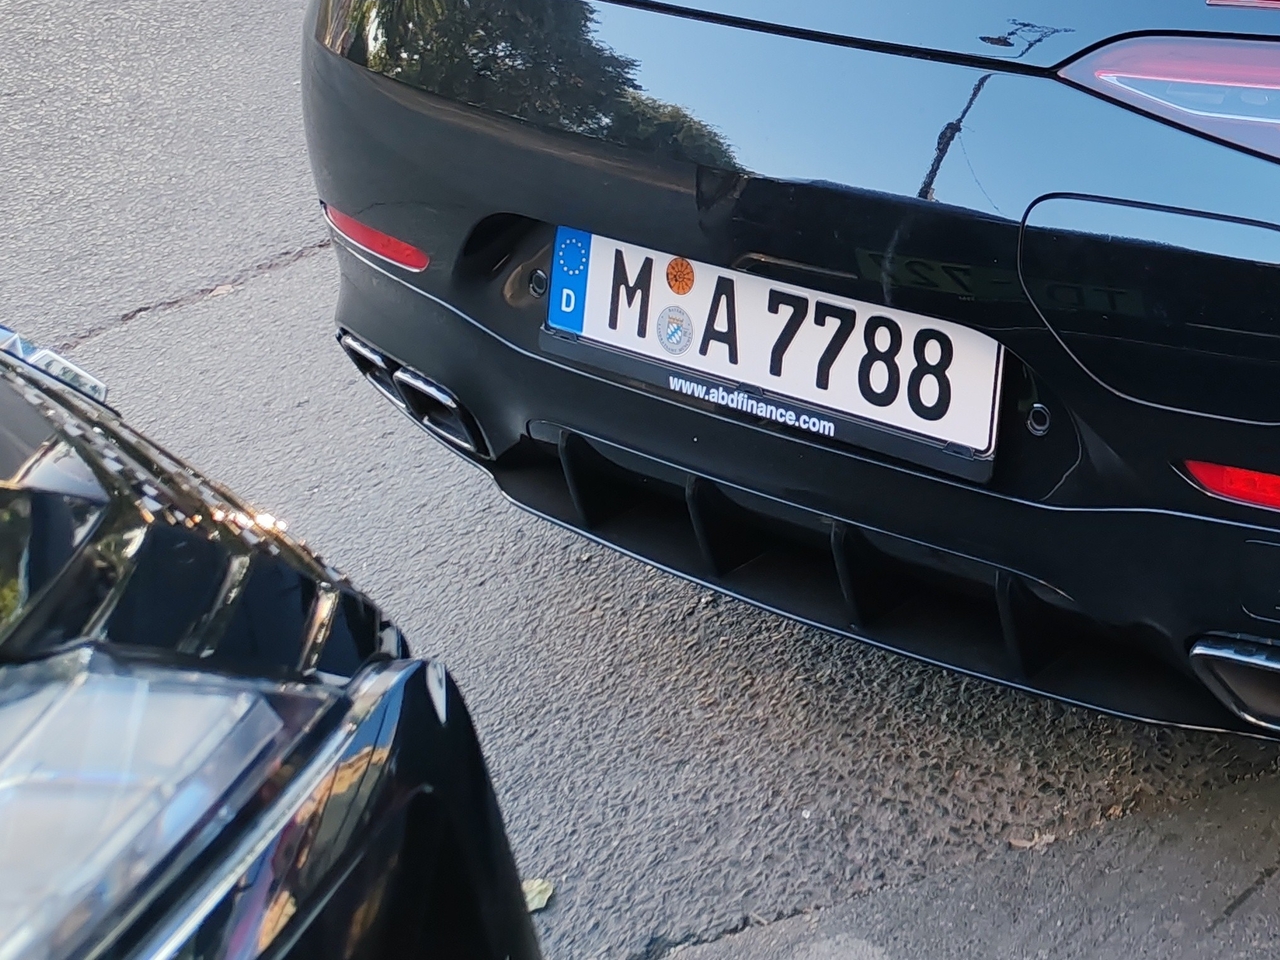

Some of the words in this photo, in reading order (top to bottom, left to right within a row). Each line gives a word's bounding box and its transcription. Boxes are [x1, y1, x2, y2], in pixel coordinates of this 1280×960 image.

[559, 287, 575, 313] D
[608, 248, 654, 338] M
[766, 288, 954, 421] 7788
[669, 376, 835, 437] www.abdfinance.com
